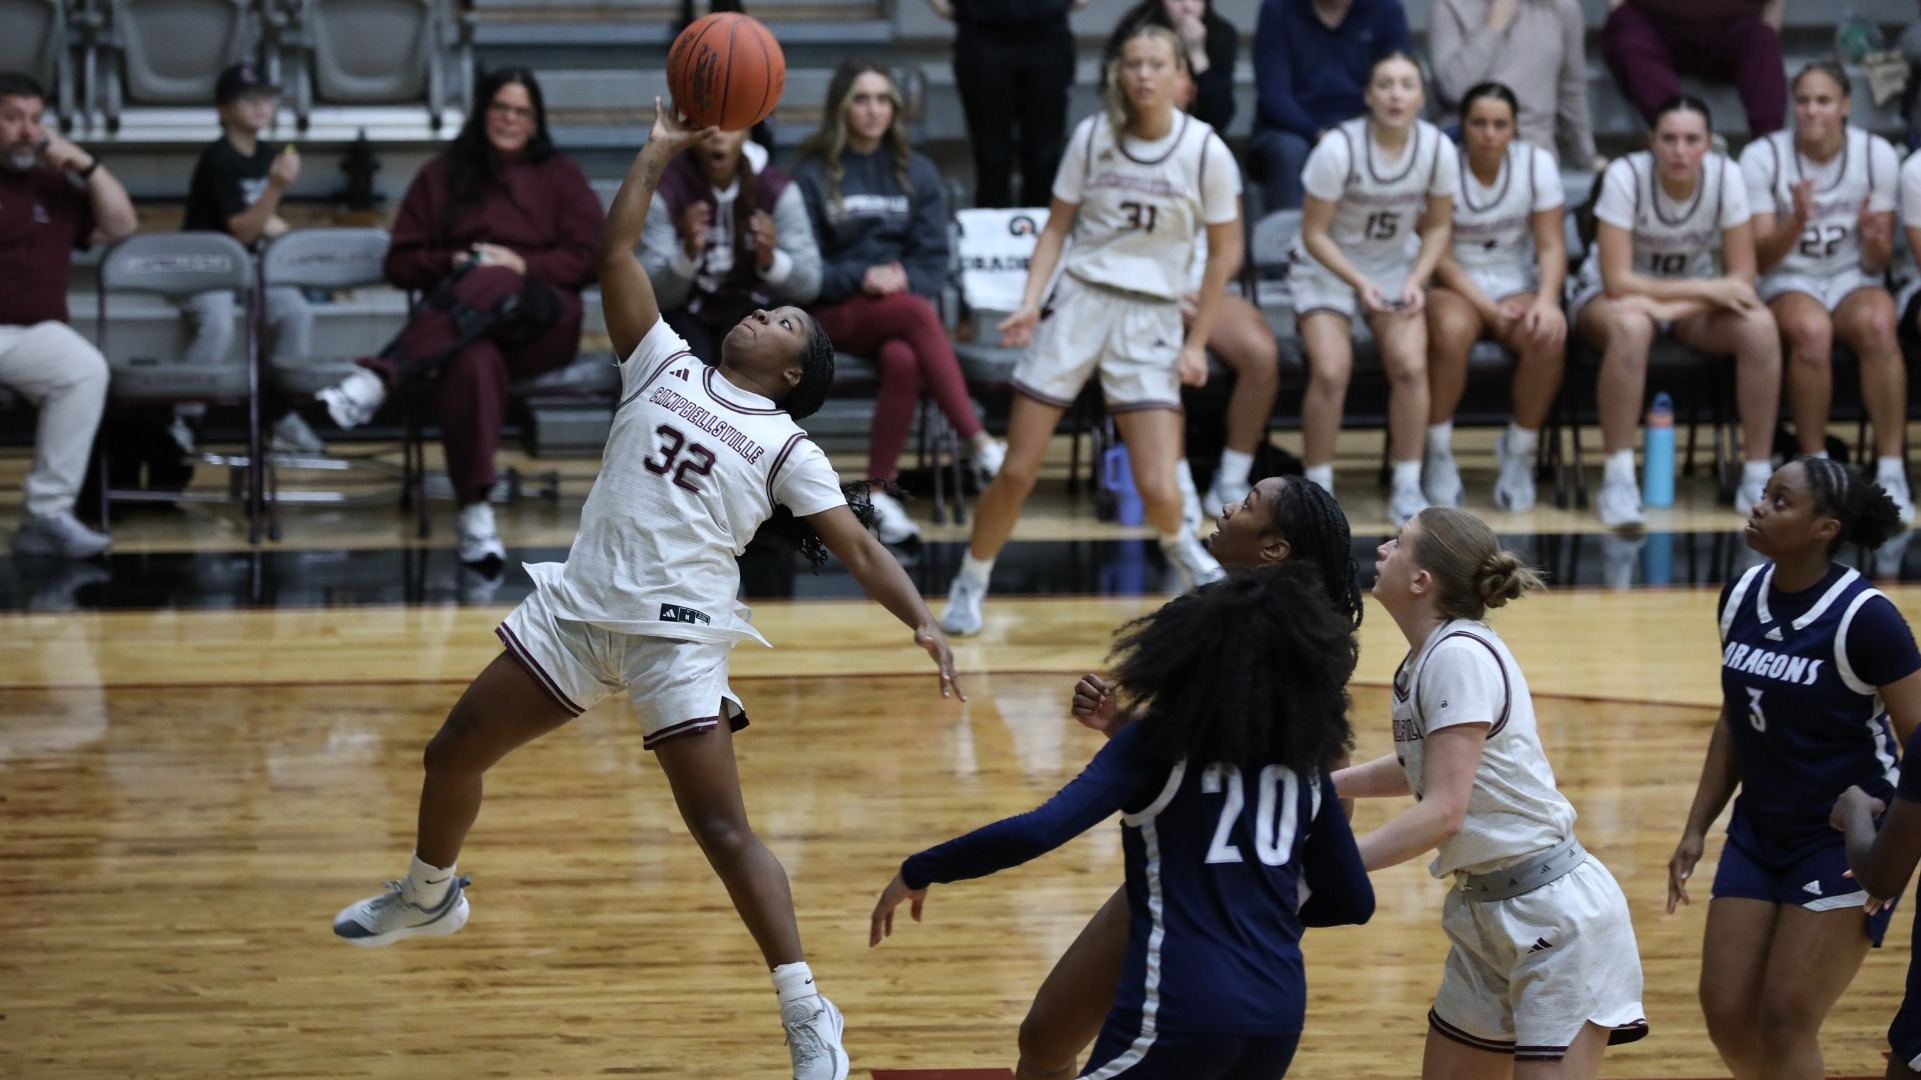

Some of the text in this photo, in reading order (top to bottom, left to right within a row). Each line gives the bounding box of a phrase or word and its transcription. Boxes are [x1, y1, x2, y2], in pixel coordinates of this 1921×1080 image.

[1118, 201, 1156, 233] 31
[1365, 212, 1402, 240] 15
[649, 386, 765, 465] CAMPBELLSVILLE
[643, 424, 717, 494] 32
[1723, 641, 1826, 686] DRAGONS
[1745, 686, 1766, 733] 3
[1201, 762, 1298, 867] 20
